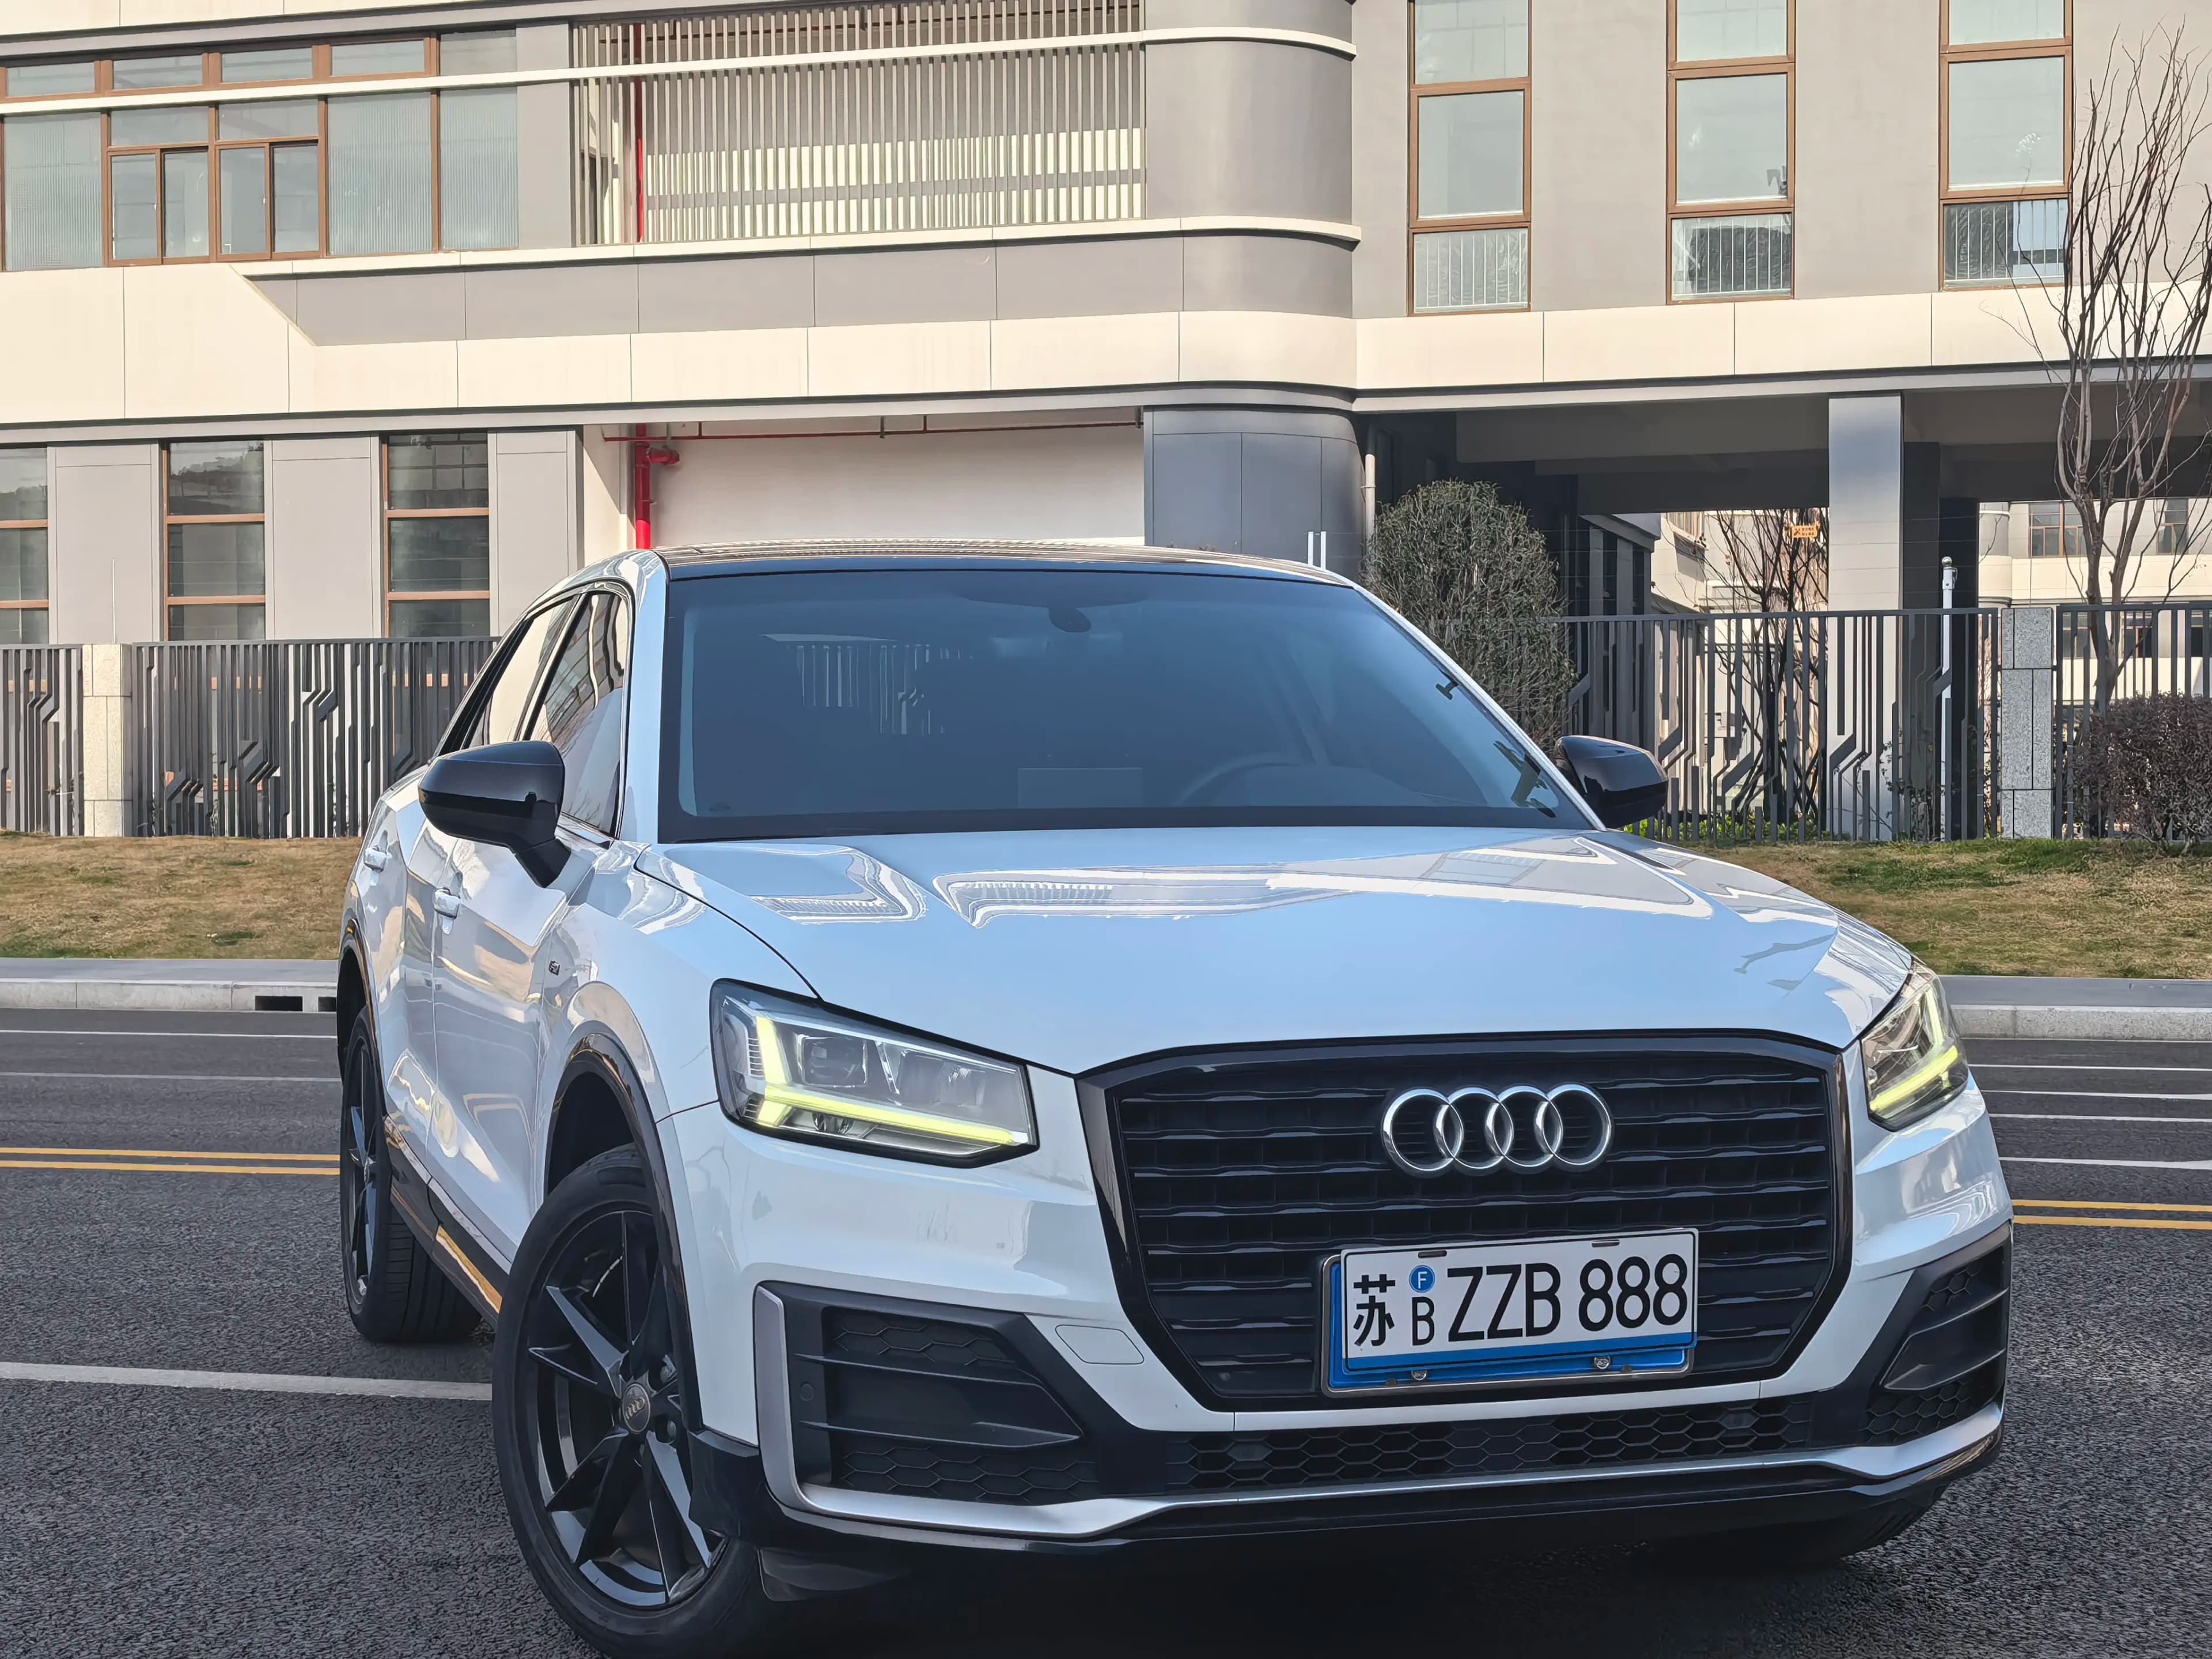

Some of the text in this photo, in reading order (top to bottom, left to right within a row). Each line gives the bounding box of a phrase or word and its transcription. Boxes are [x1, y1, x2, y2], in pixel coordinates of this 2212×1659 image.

[1353, 1253, 1688, 1347] 苏 B ZZB 888
